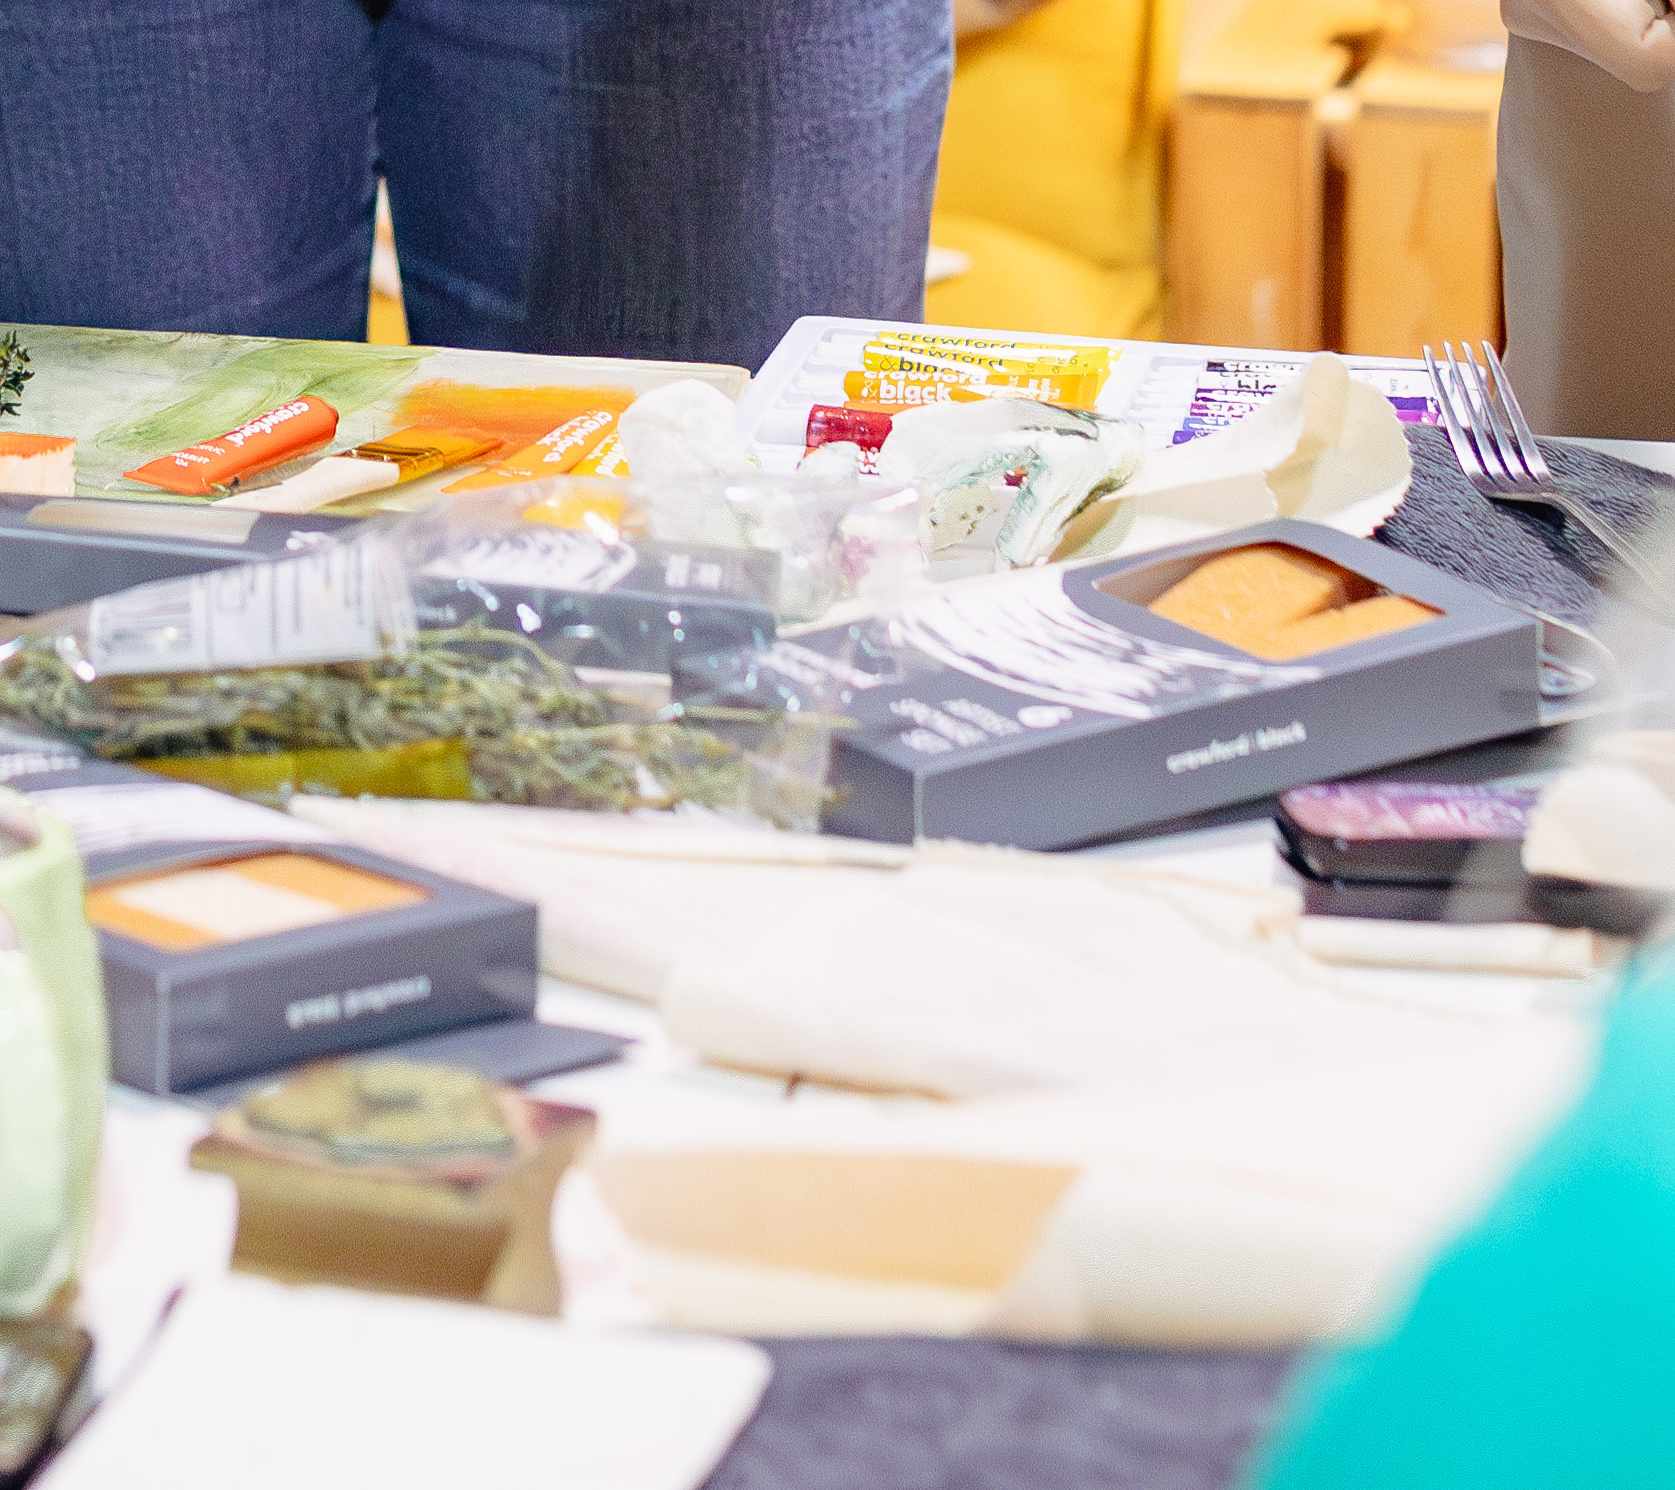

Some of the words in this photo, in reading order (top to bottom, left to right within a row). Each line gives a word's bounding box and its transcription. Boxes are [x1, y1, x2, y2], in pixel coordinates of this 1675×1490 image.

[897, 333, 1016, 349] crawford
[884, 344, 1004, 368] crawford
[879, 379, 953, 401] black
[225, 401, 310, 447] crawford
[542, 410, 614, 463] crawford
